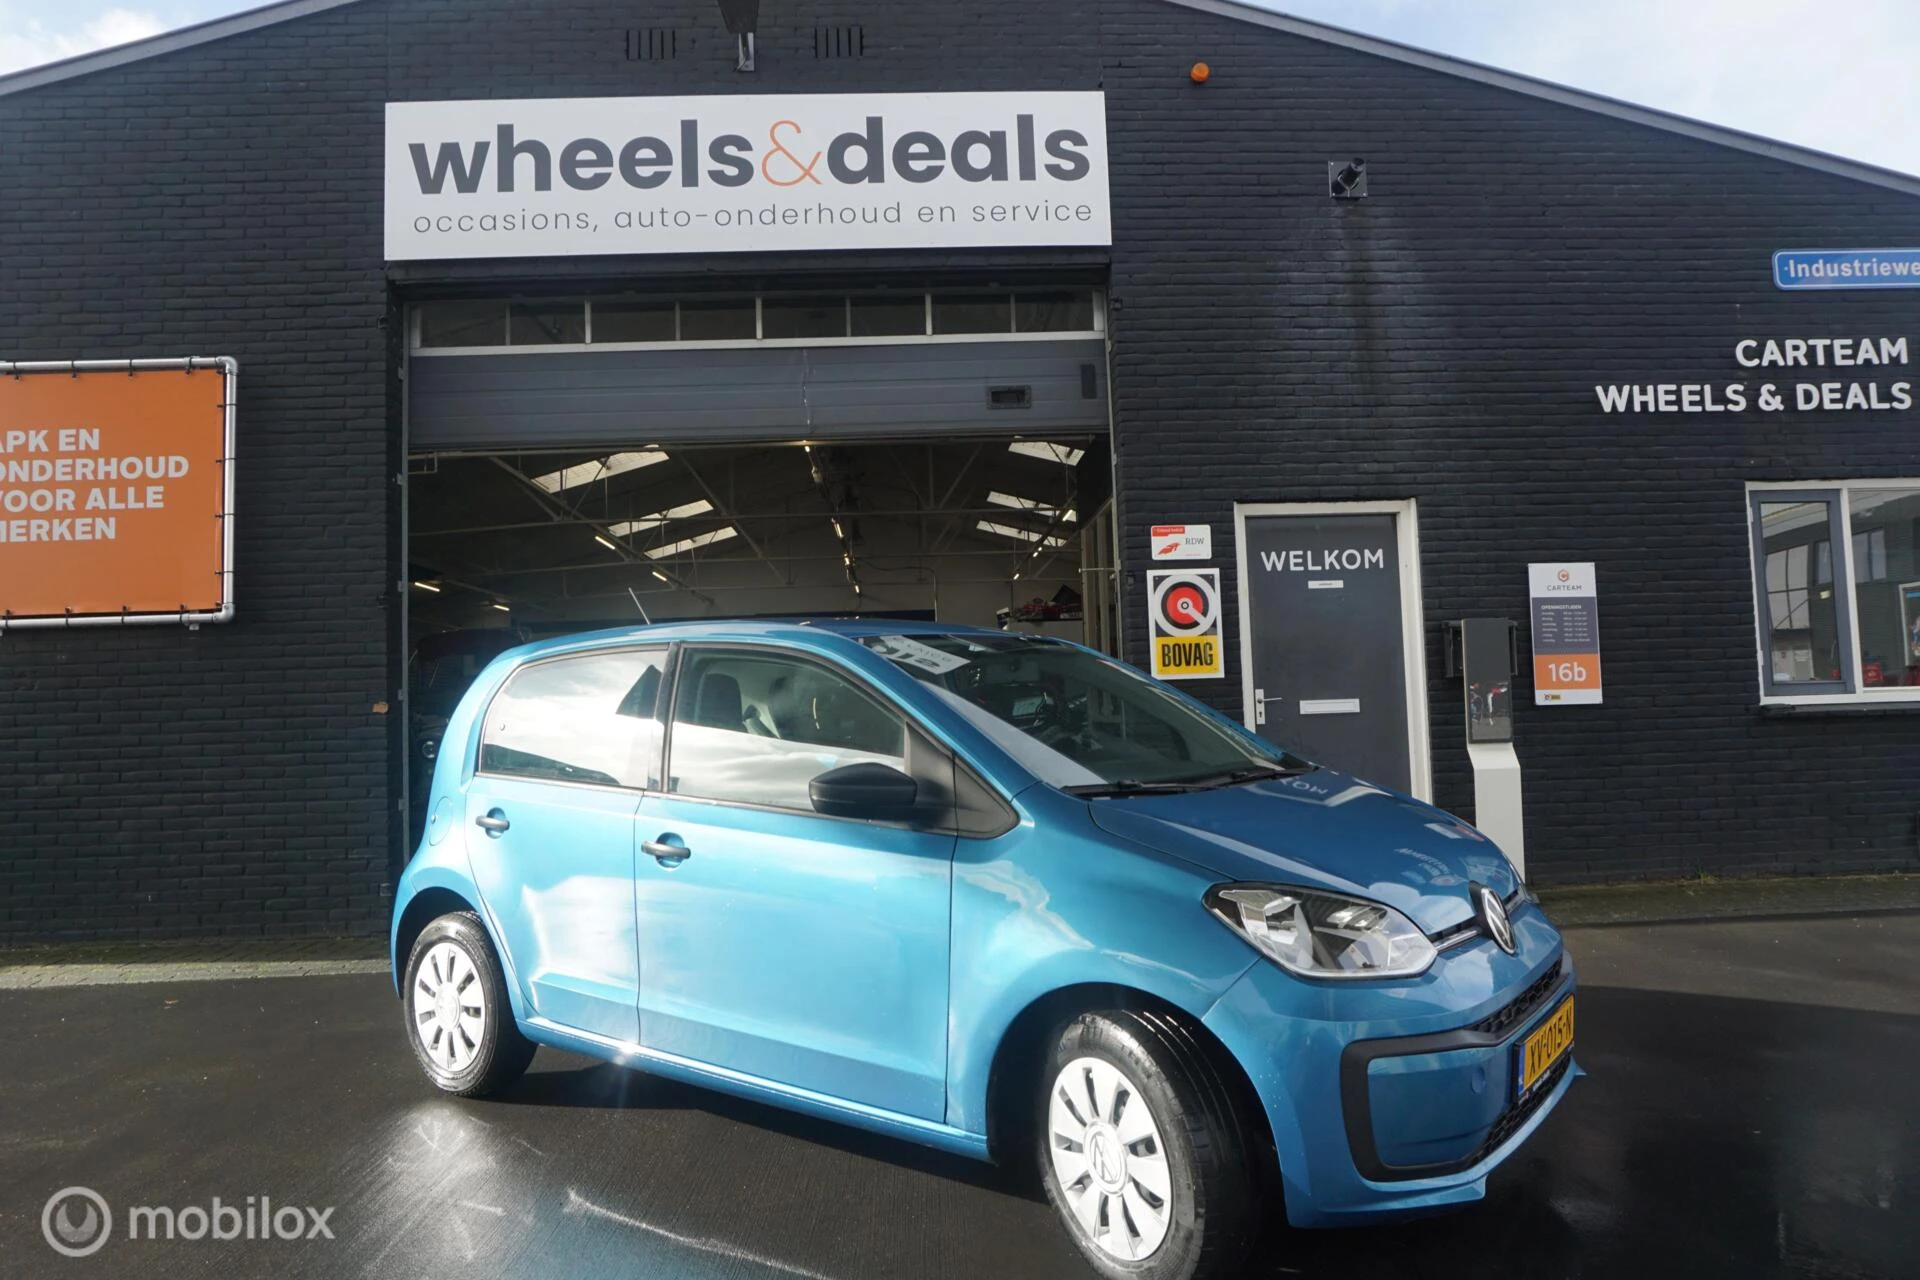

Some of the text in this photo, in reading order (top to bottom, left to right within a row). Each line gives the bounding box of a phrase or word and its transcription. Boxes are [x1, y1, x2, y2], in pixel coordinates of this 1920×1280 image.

[408, 114, 1090, 195] wheels&deals
[414, 200, 1092, 233] occasions, auto-onderhoud en service
[1735, 337, 1909, 368] CARTEAM
[1595, 382, 1912, 413] WHEELS & DEALS
[0, 428, 101, 453] PK EN
[0, 455, 190, 483] NDERHOUD
[0, 485, 165, 513] OOR ALLE
[0, 517, 117, 543] ERKEN
[1185, 537, 1205, 546] RDW
[1260, 548, 1384, 572] WELKOM
[1547, 584, 1582, 592] CARTEAM
[1160, 641, 1214, 668] BOVAG
[1547, 661, 1587, 683] 16b
[1530, 1007, 1572, 1077] XV-015-N
